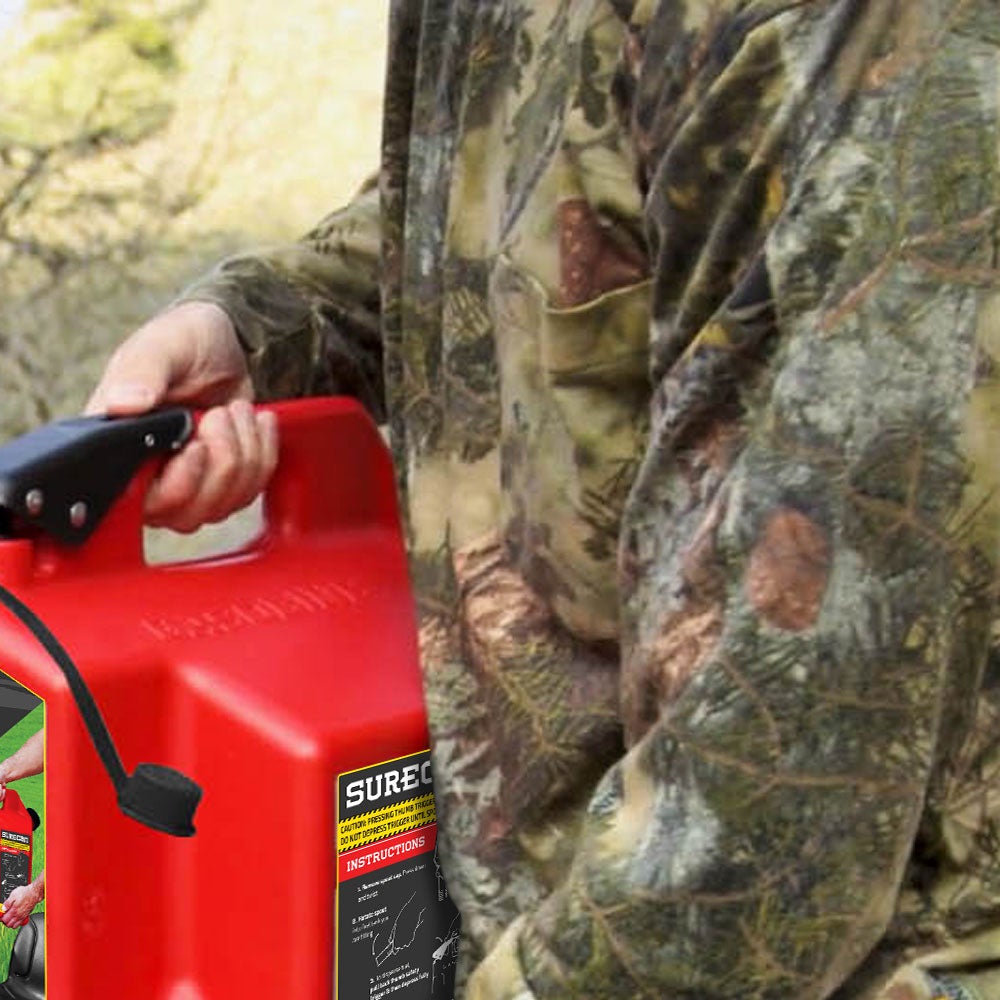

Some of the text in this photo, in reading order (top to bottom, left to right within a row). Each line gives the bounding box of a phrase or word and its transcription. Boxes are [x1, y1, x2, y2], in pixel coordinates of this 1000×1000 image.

[340, 820, 367, 834] CAUTION:
[367, 811, 394, 826] PRESSING
[395, 805, 415, 817] THUMB
[340, 835, 349, 845] DO
[350, 831, 362, 843] NOT
[362, 823, 387, 838] DEPRESS
[387, 816, 410, 831] TRIGGER
[411, 812, 426, 823] UNTIL
[346, 836, 426, 873] INSTRUCTIONS
